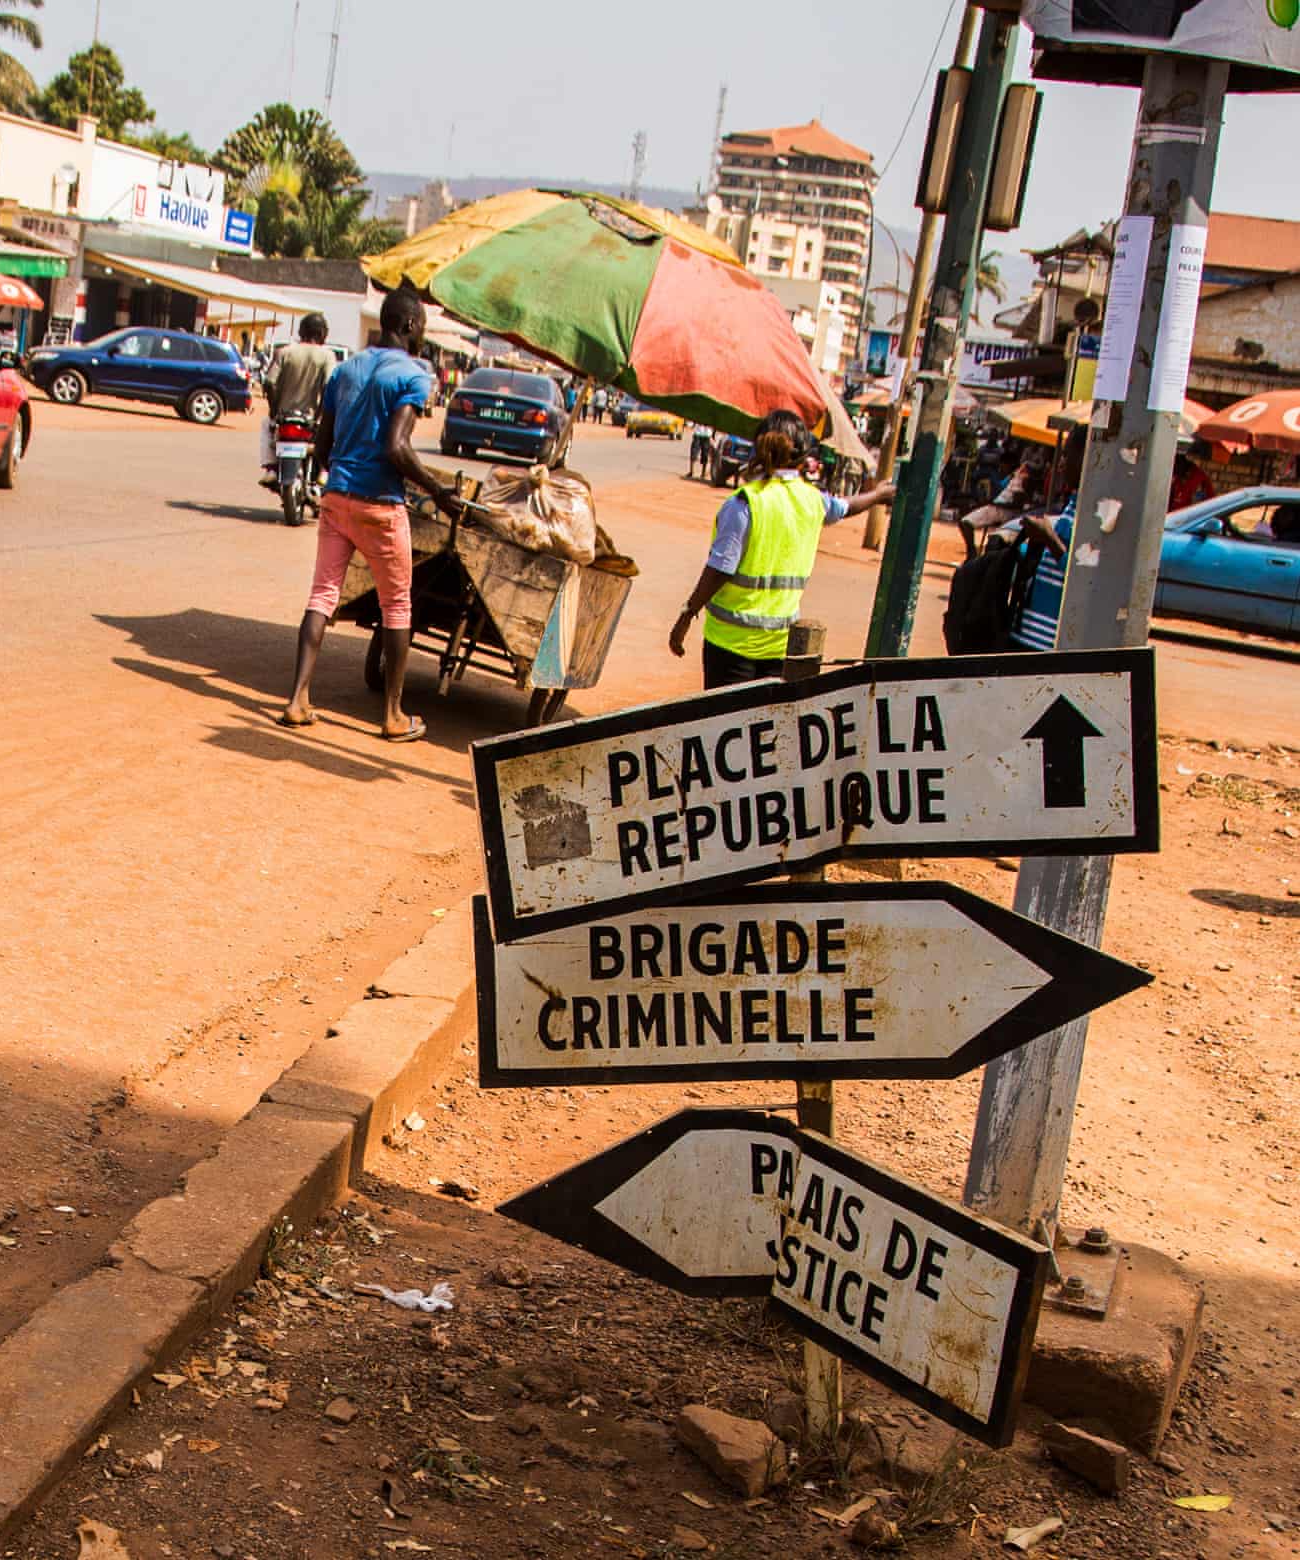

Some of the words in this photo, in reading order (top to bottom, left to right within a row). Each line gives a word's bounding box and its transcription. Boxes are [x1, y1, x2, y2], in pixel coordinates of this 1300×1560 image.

[607, 719, 780, 808] PLACE
[797, 701, 858, 770] DE
[875, 695, 947, 753] LA
[616, 767, 948, 878] REPUBLIQUE
[588, 917, 847, 981] BRIGADE
[537, 987, 877, 1052] CRIMINELLE
[750, 1142, 866, 1252] PAAIS
[882, 1217, 950, 1303] DE
